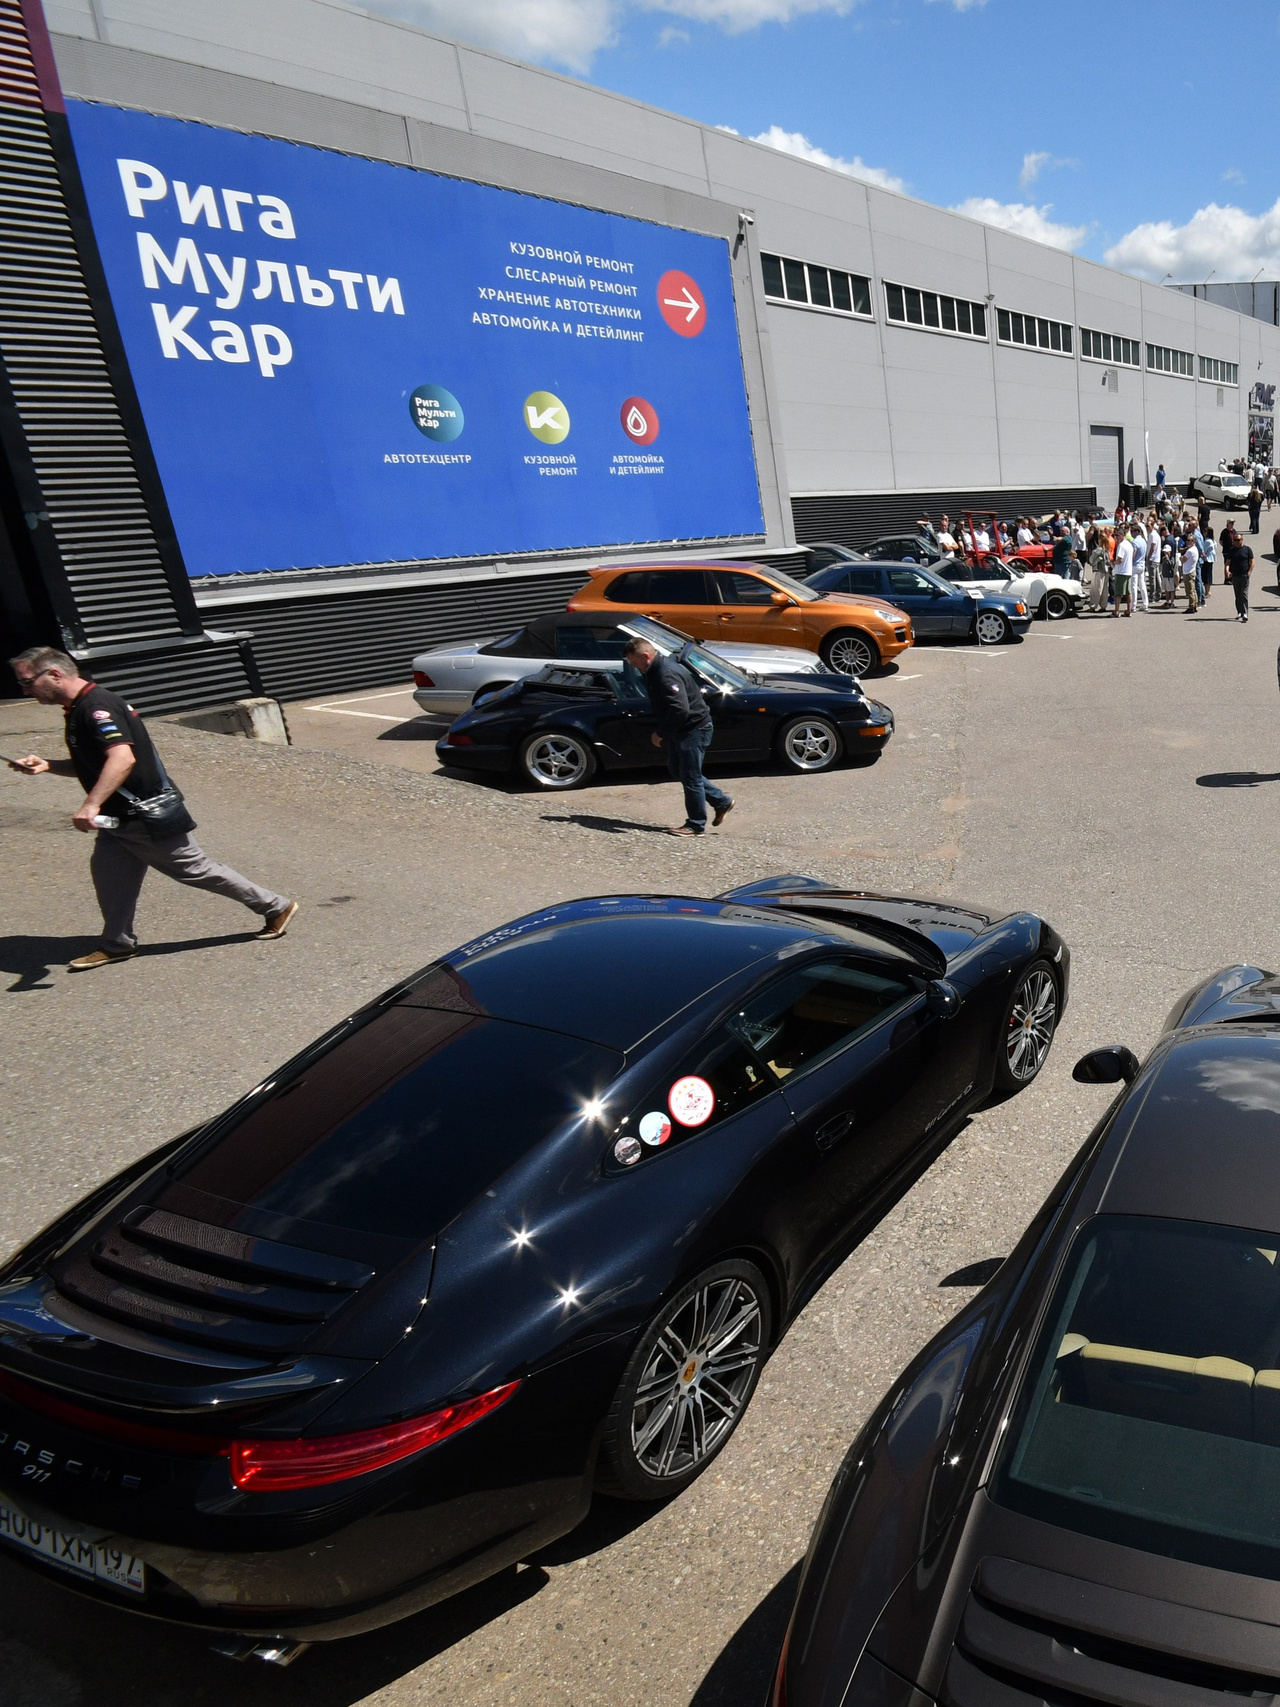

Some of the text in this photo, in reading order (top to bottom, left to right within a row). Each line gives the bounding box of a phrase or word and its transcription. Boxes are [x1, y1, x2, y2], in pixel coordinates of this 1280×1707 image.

[116, 158, 296, 239] Рига
[509, 241, 634, 274] КУЗОВНОЙ РЕМОНТ
[136, 231, 405, 315] Мульти
[505, 266, 638, 297] СЛЕСАРНЫЙ РЕМОНТ
[478, 287, 642, 320] ХРАНЕНИЕ АВТОТЕХНИКИ
[472, 312, 645, 342] АВТОМОЙКА И ДЕТЕЙЛИНГ
[151, 302, 293, 377] Кар
[414, 397, 440, 408] Рига
[417, 407, 457, 419] Мульти
[419, 417, 440, 429] Кар
[383, 454, 472, 465] АВТОТЕХЦЕНТР
[524, 453, 576, 465] КУЗОВНОЙ
[612, 453, 664, 464] АВТОМОЙКА
[539, 467, 578, 476] РЕМОНТ
[618, 465, 665, 475] ДЕТЕЙЛИНГ
[22, 1465, 51, 1482] 911
[107, 1567, 126, 1582] RUS
